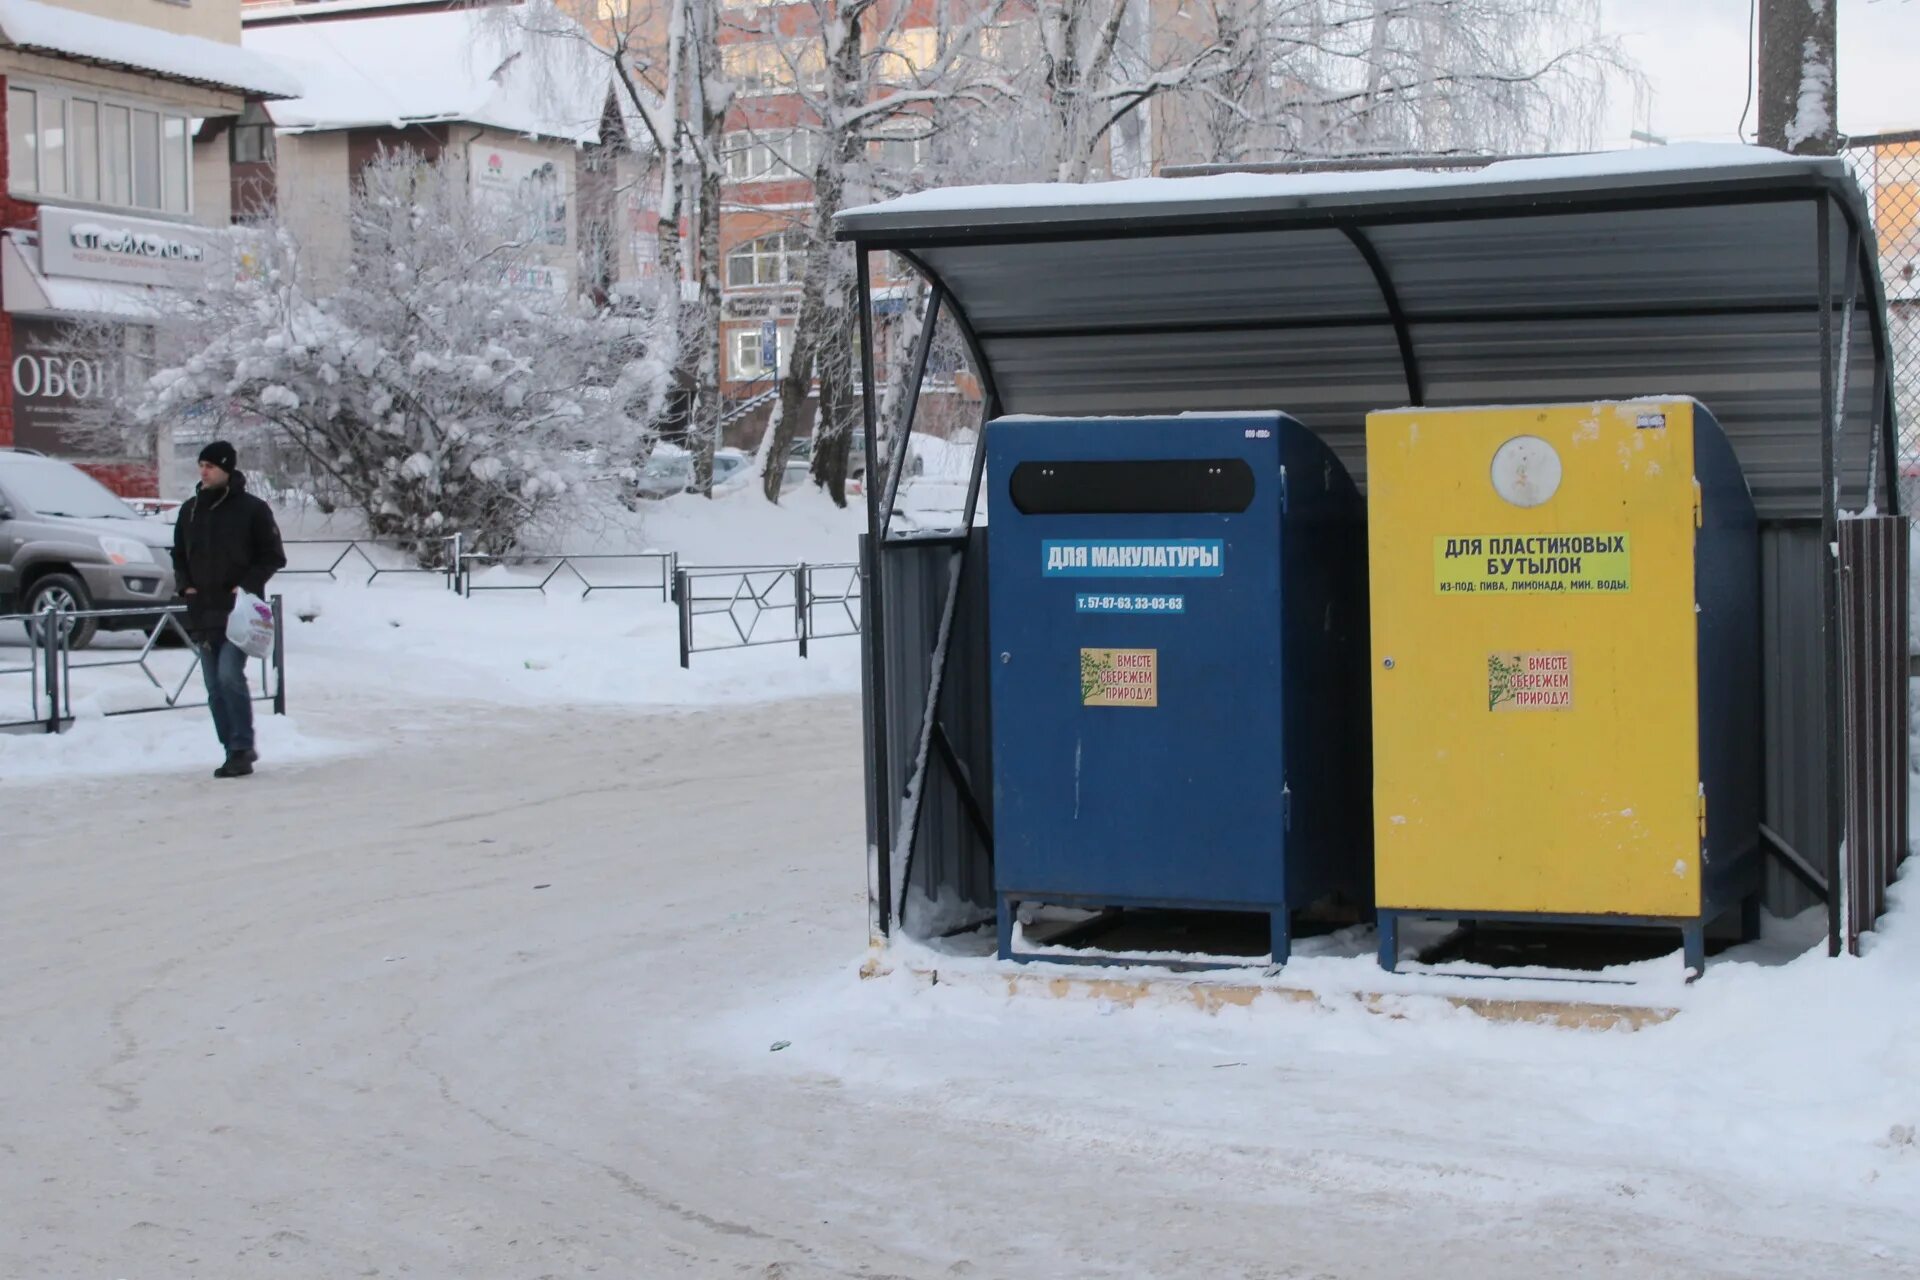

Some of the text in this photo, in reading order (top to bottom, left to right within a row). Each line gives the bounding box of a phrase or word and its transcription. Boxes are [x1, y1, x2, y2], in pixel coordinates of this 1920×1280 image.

[1445, 536, 1624, 558] ДЛЯ ПЛАСТИКОВЫХ
[1048, 546, 1218, 570] ДЛЯ МАКУЛАТУРЫ
[1487, 557, 1581, 575] БУТЫЛОК
[1440, 580, 1629, 592] ИЗ-ПОД: ПИВА, ЛИМОНАДА, МИН. ВОДЫ.
[1117, 655, 1151, 667] ВМЕСТЕ
[1529, 657, 1567, 670] ВМЕСТЕ
[1101, 671, 1152, 684] СБЕРЕЖЕМ
[1510, 674, 1568, 688] СБЕРЕЖЕМ
[1106, 687, 1152, 700] ПРИРОДУ!
[1516, 692, 1568, 705] ПРИРОДУ!
